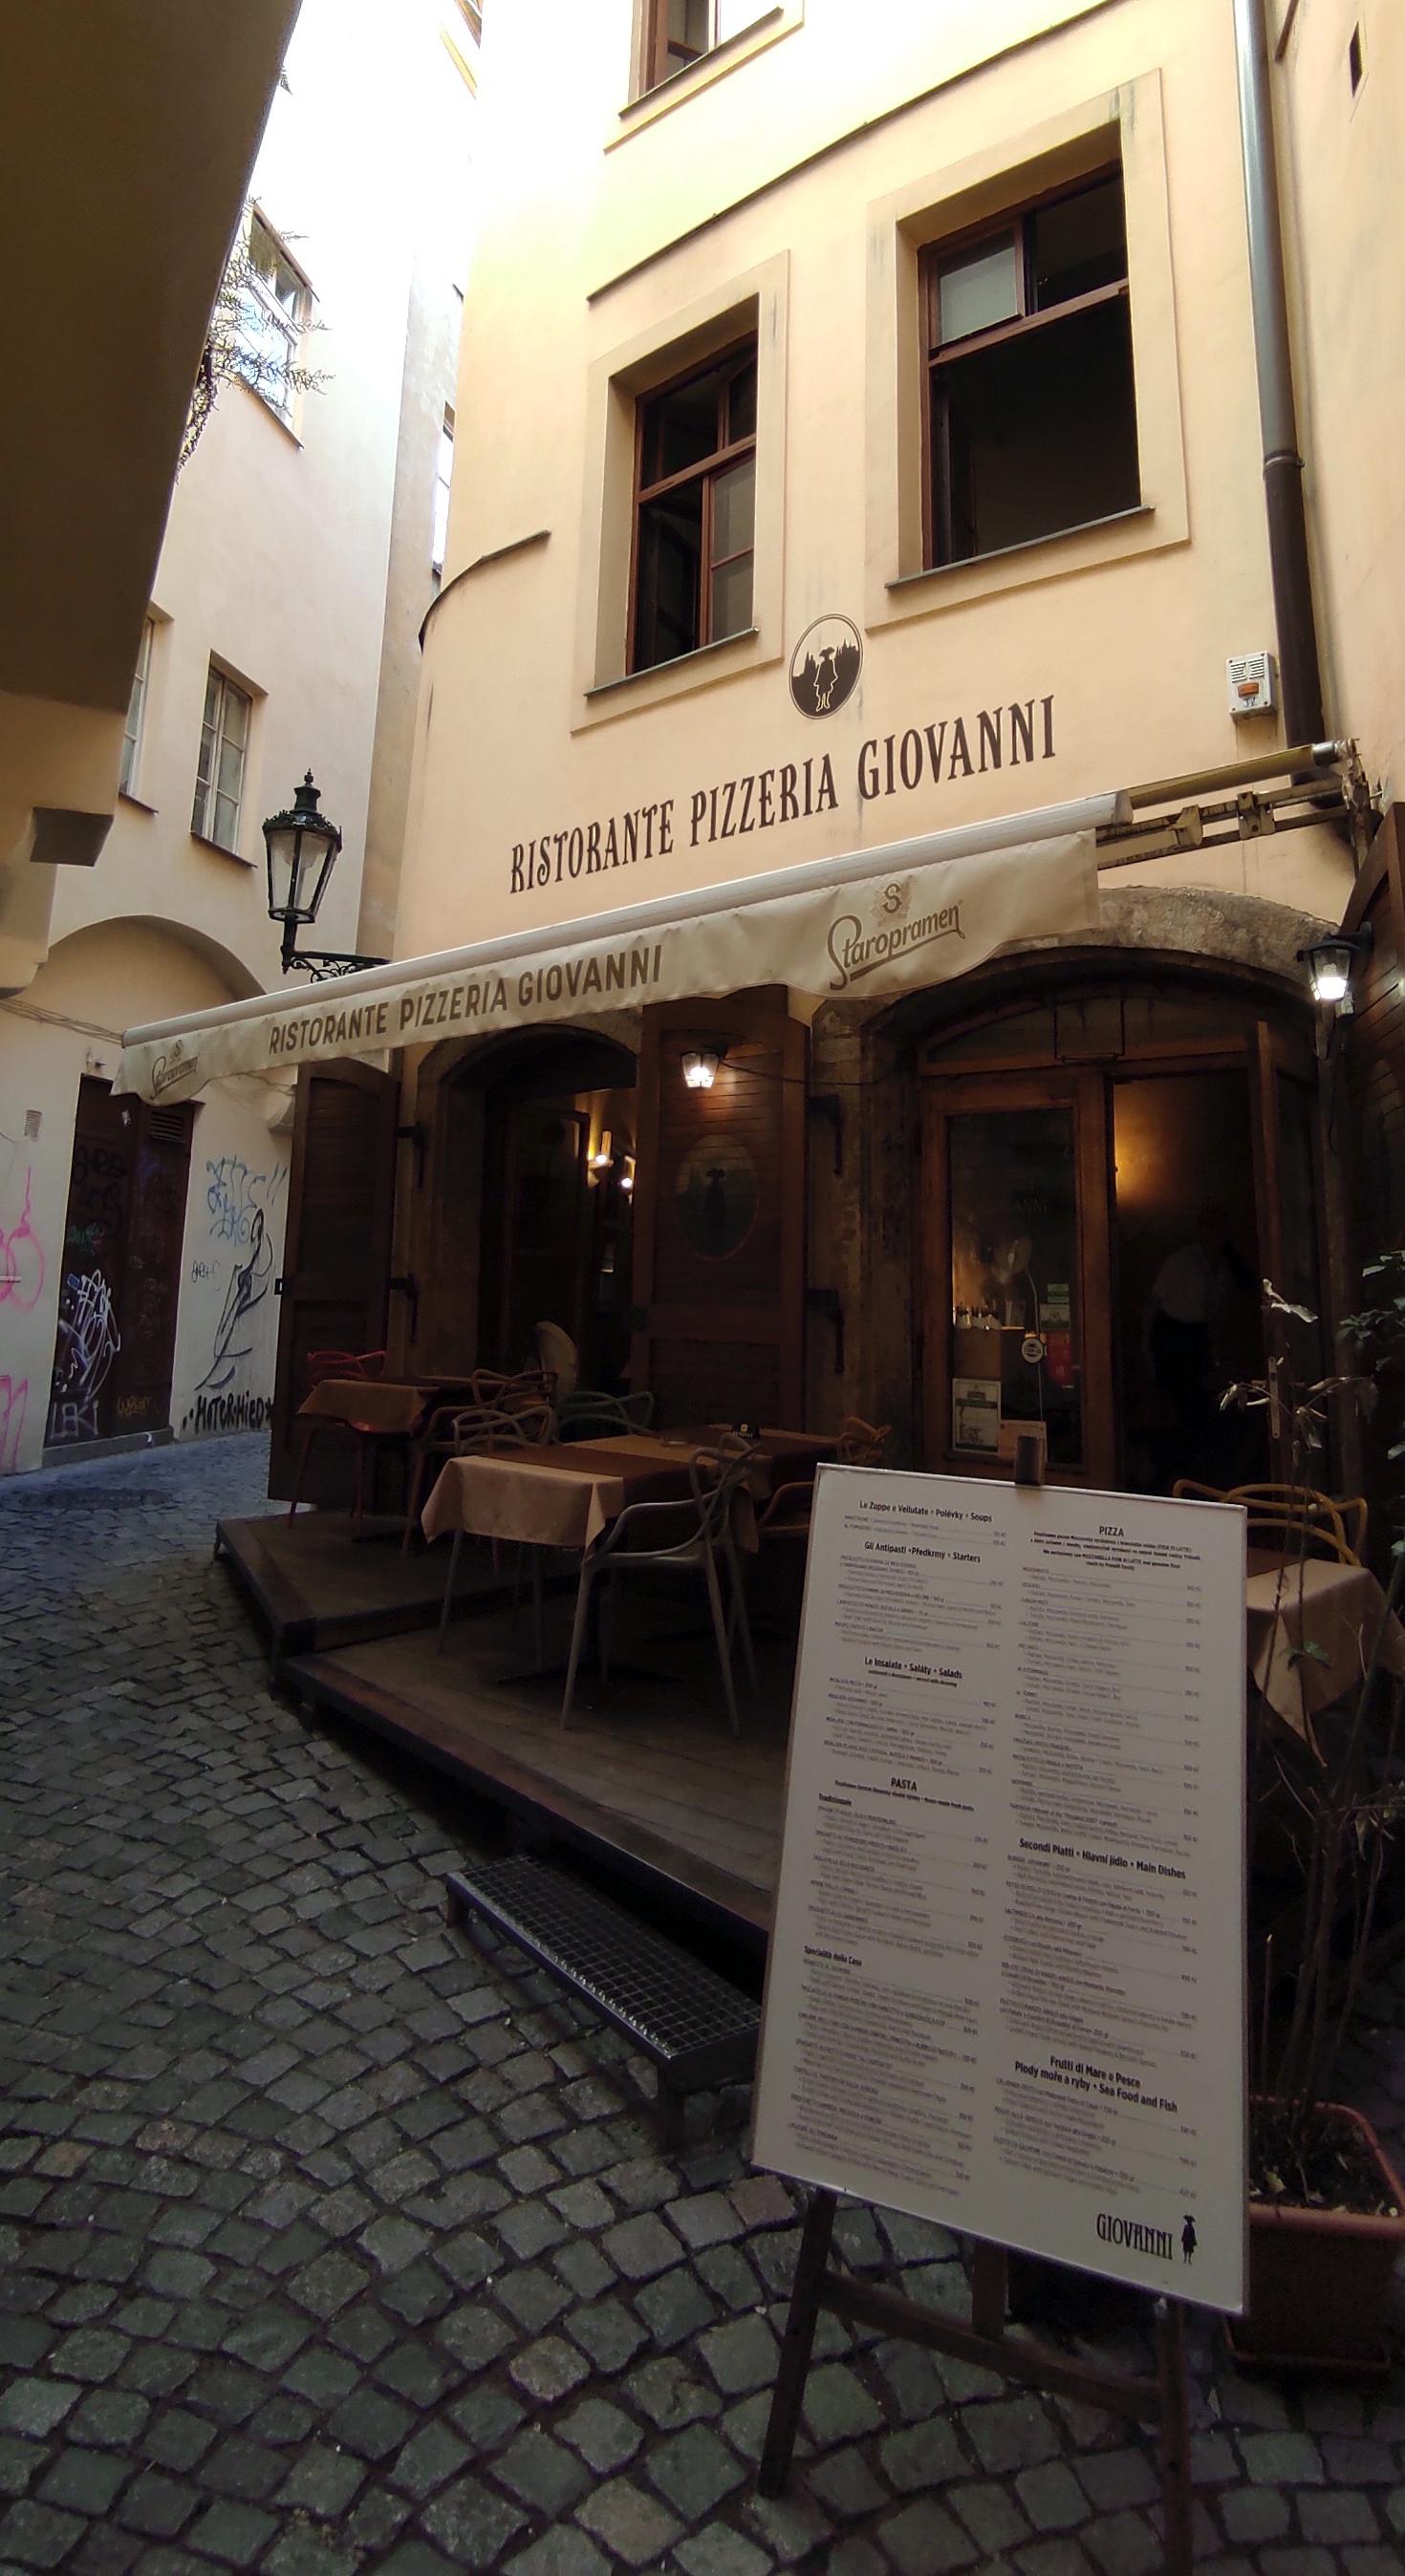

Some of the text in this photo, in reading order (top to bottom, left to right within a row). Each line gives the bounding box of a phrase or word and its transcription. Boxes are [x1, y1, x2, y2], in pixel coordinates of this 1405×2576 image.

[510, 695, 1056, 893] RISTORANTE PIZZERIA GIOVANNI
[828, 905, 965, 990] Staropramen
[269, 944, 661, 1055] RISTORANTE PIZZERIA GIOVANNI
[870, 1501, 891, 1512] Zuppe
[898, 1505, 929, 1515] Vellutate
[936, 1509, 963, 1520] Polévky
[971, 1513, 992, 1522] Soups
[1099, 1526, 1124, 1536] PIZZA
[865, 1541, 981, 1562] Gli Antipasti Předkrmy Starters
[865, 1657, 962, 1679] Le Insalate Saláty Salads
[891, 1777, 917, 1791] PASTA
[1020, 1838, 1185, 1878] Secondi Piatti Hlavní jídlo Main Dishes
[833, 1952, 847, 1963] della
[849, 1957, 862, 1966] Casa
[1015, 2061, 1039, 2077] Plody
[1041, 2070, 1062, 2083] moře
[1071, 2077, 1090, 2091] ryby
[1099, 2084, 1114, 2095] Sea
[1117, 2088, 1138, 2102] Food
[1141, 2095, 1157, 2107] and
[1159, 2098, 1178, 2113] Fish
[1050, 2055, 1073, 2071] Frutti
[1075, 2063, 1084, 2072] di
[1086, 2066, 1107, 2079] Mare
[1116, 2072, 1140, 2088] Pesce
[1096, 2213, 1173, 2260] GIOVANNI
